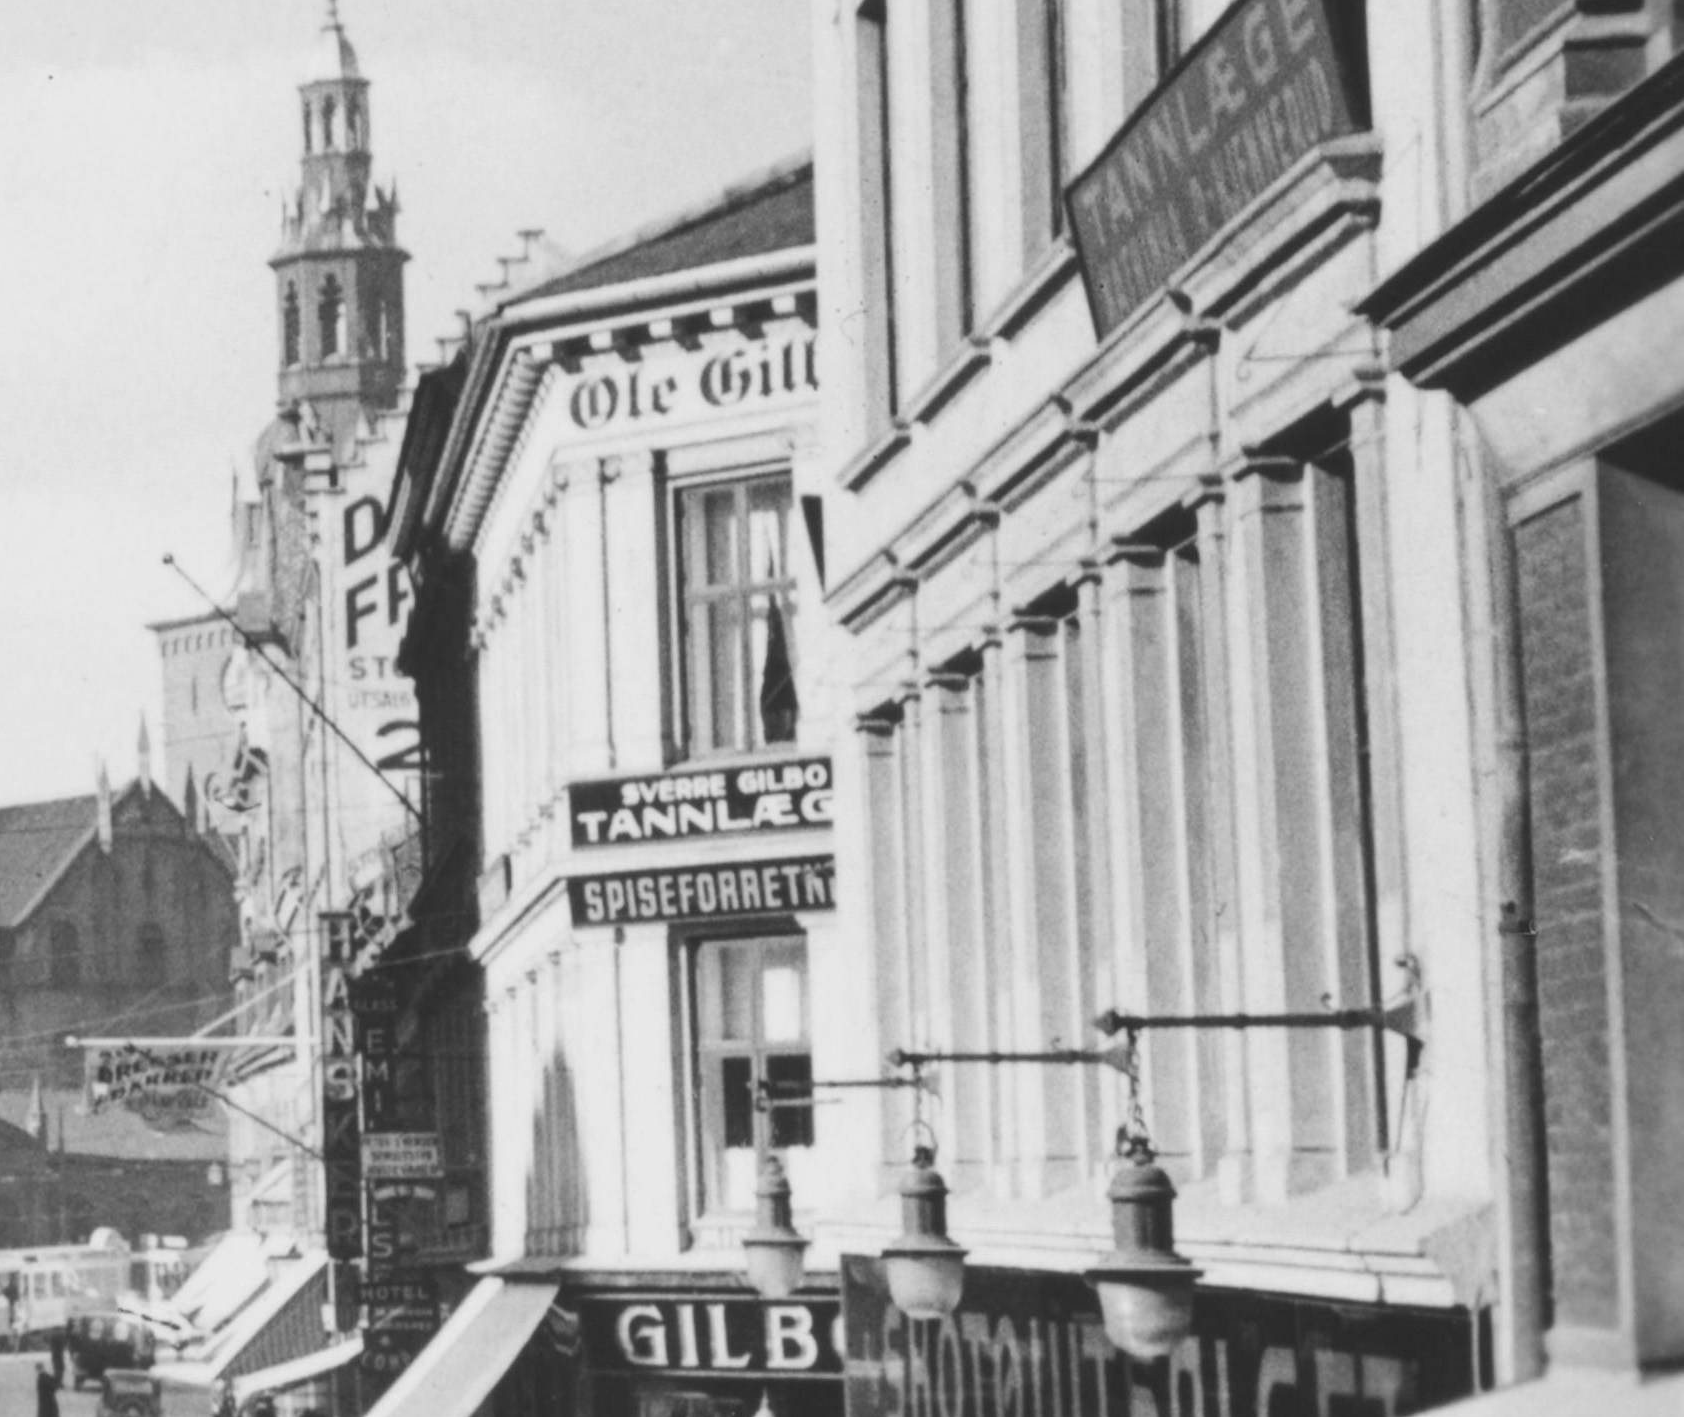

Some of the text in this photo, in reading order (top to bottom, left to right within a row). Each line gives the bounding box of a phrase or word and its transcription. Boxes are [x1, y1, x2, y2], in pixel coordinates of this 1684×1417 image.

[570, 375, 677, 429] Ole
[621, 772, 726, 807] SVERRE
[618, 1303, 842, 1370] GILB
